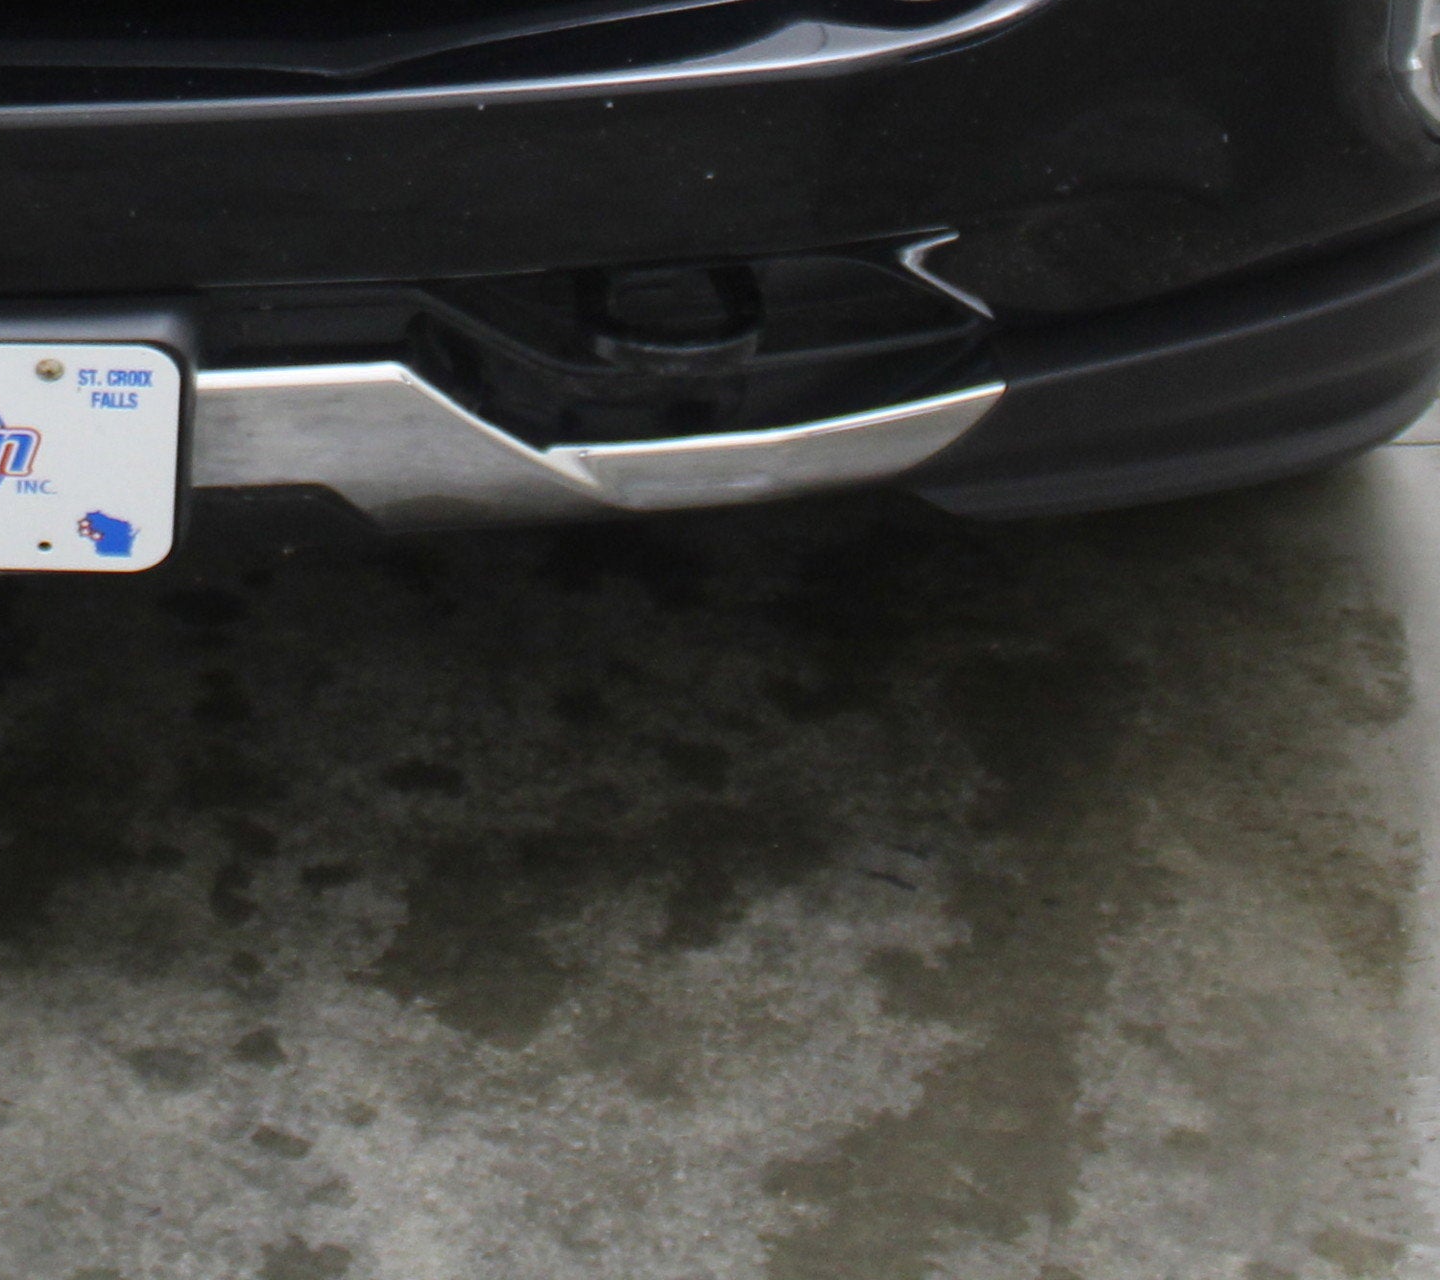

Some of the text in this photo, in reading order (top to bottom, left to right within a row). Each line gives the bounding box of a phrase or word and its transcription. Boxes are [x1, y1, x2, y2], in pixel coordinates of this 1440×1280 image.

[78, 369, 152, 387] ST. CROIX
[91, 392, 138, 408] FALLS
[16, 480, 57, 494] INC.
